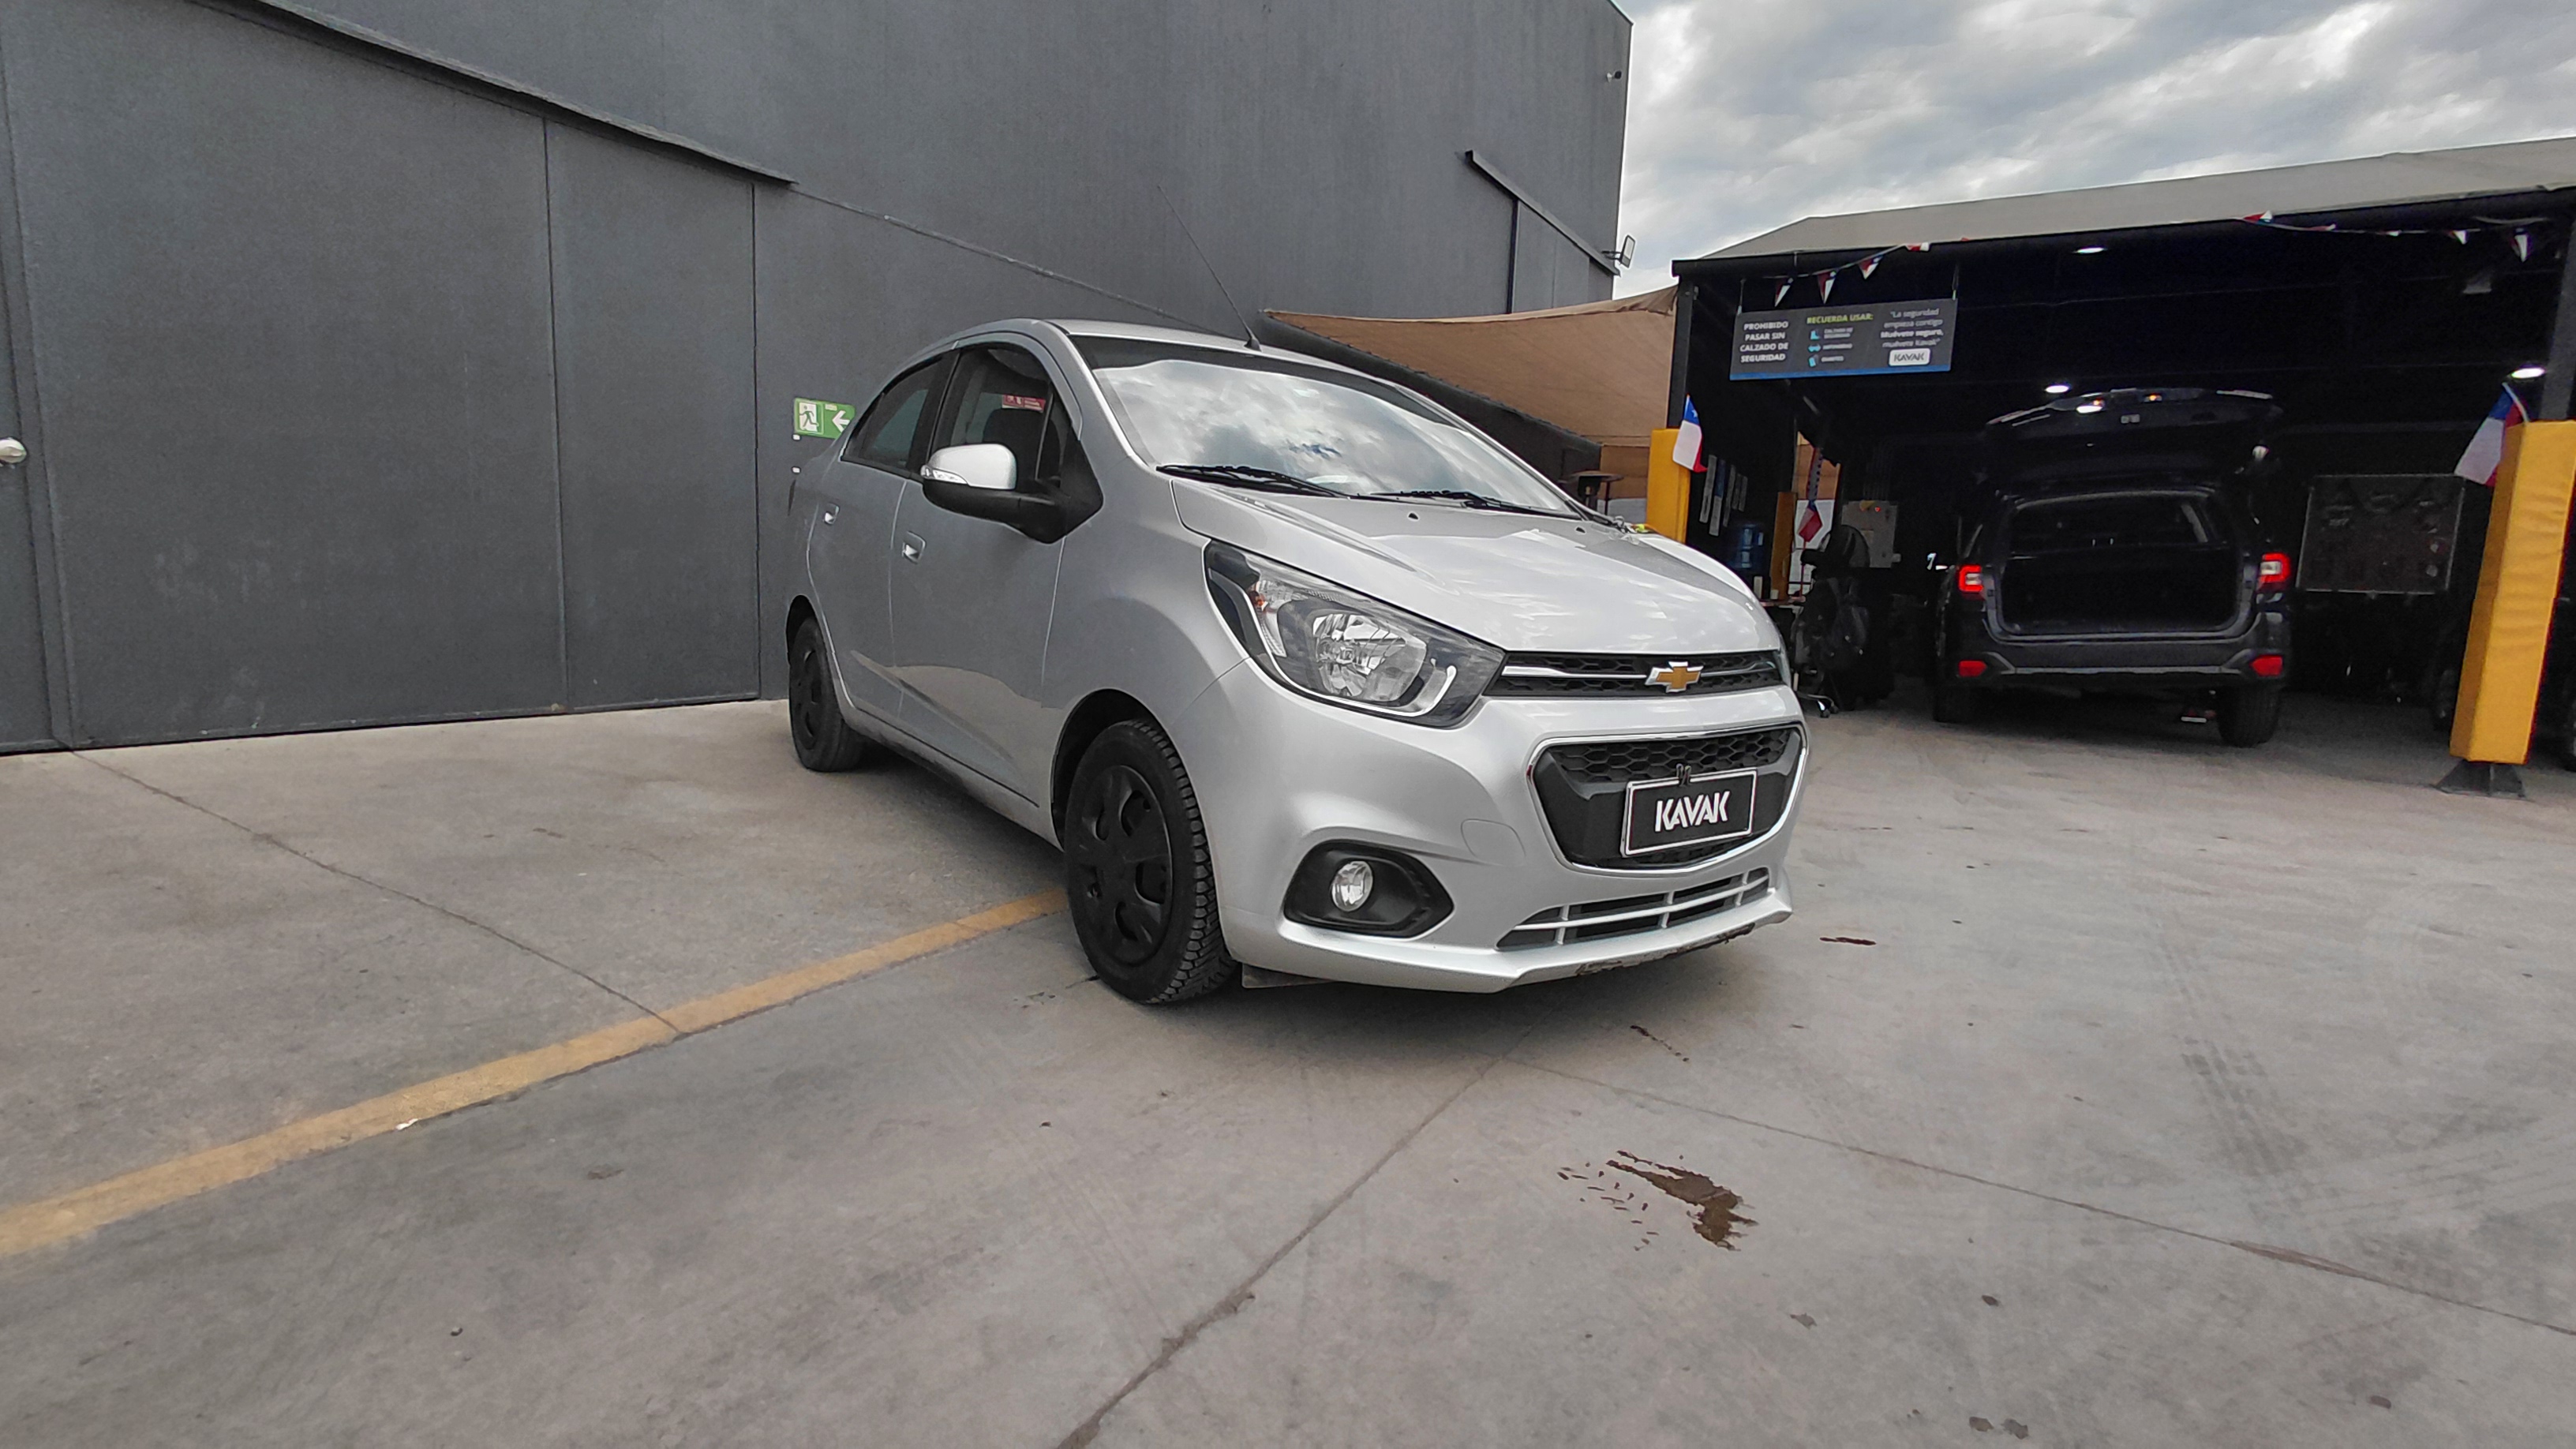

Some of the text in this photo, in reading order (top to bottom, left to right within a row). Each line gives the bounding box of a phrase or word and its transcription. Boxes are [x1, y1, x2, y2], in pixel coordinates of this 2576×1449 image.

[1807, 314, 1848, 324] RECUERDA
[1743, 320, 1789, 331] PROHIBIDO
[1744, 332, 1770, 341] PASAR
[1739, 342, 1789, 352] CALZADO DE
[1740, 353, 1786, 363] SEGURIDAD
[1894, 352, 1925, 362] KAVAK
[1654, 790, 1731, 833] KAVAK
